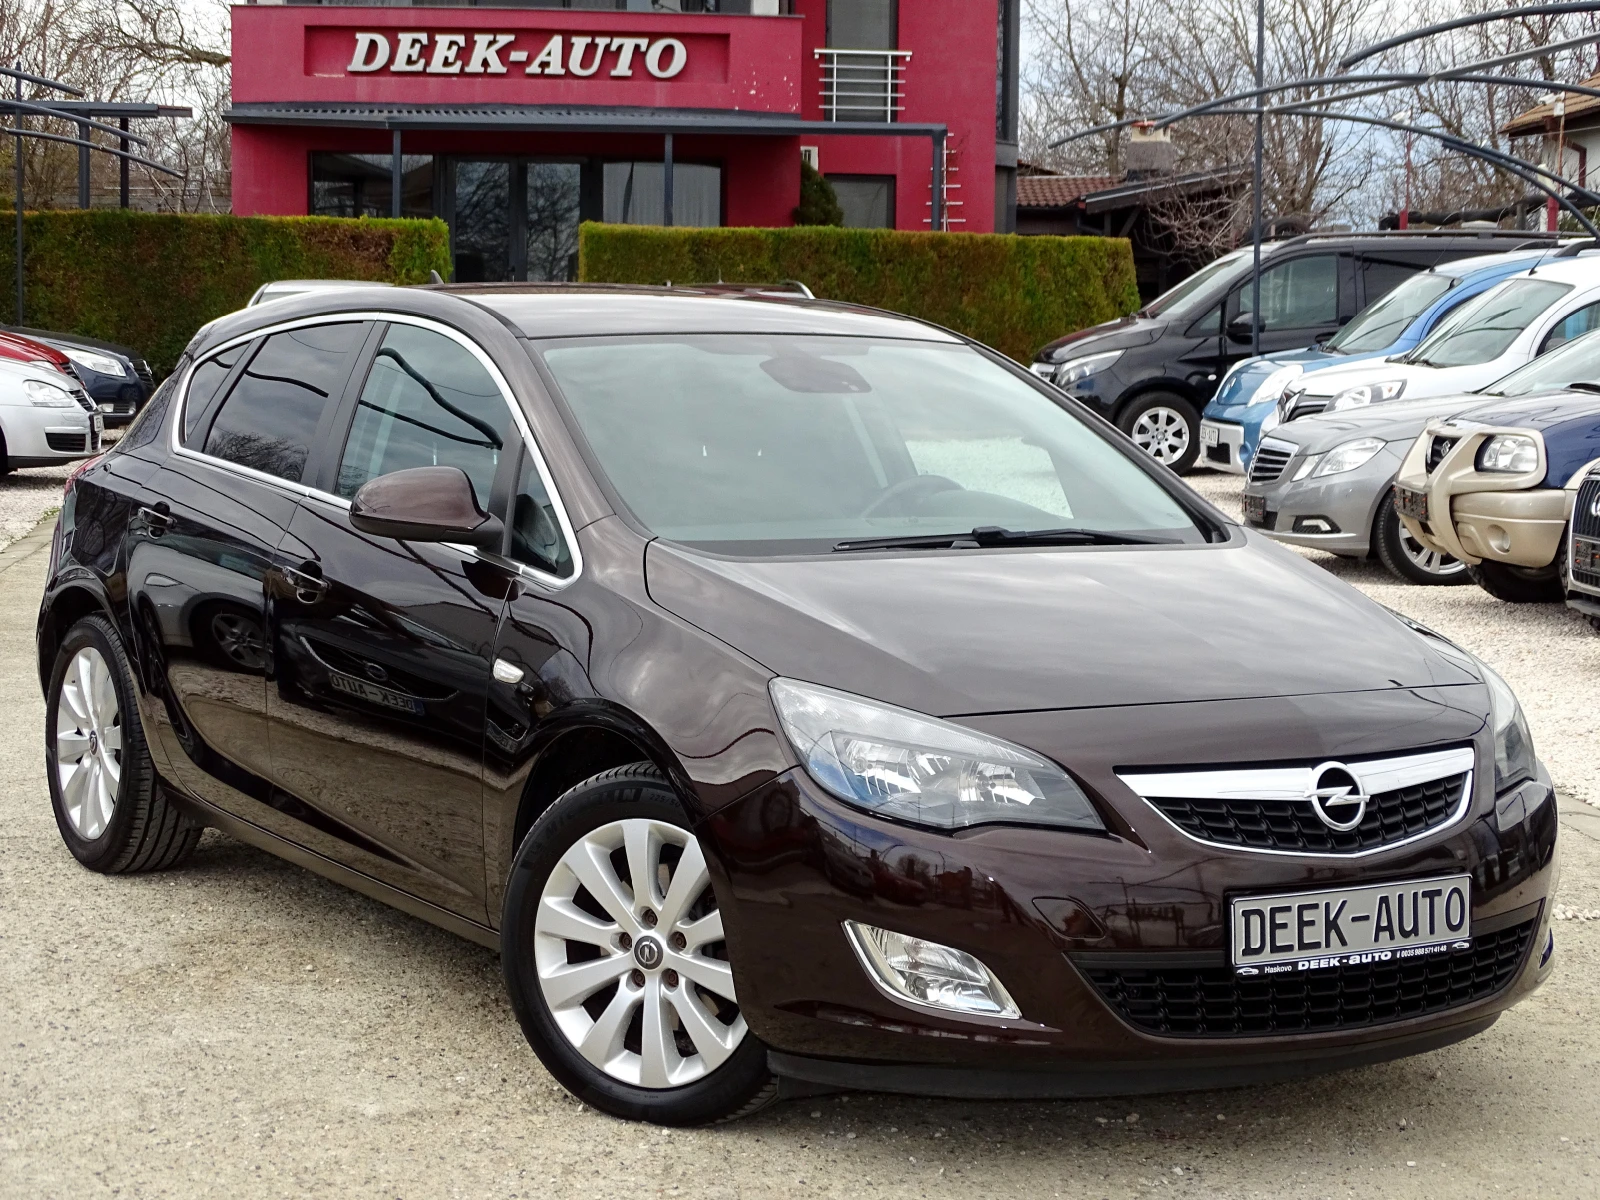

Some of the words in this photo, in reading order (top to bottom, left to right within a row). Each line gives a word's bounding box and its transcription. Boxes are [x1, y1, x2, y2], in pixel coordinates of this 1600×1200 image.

[347, 31, 688, 79] DEEK-AUTO
[1241, 887, 1466, 956] DEEK-AUTO
[1264, 964, 1293, 974] Haskovo
